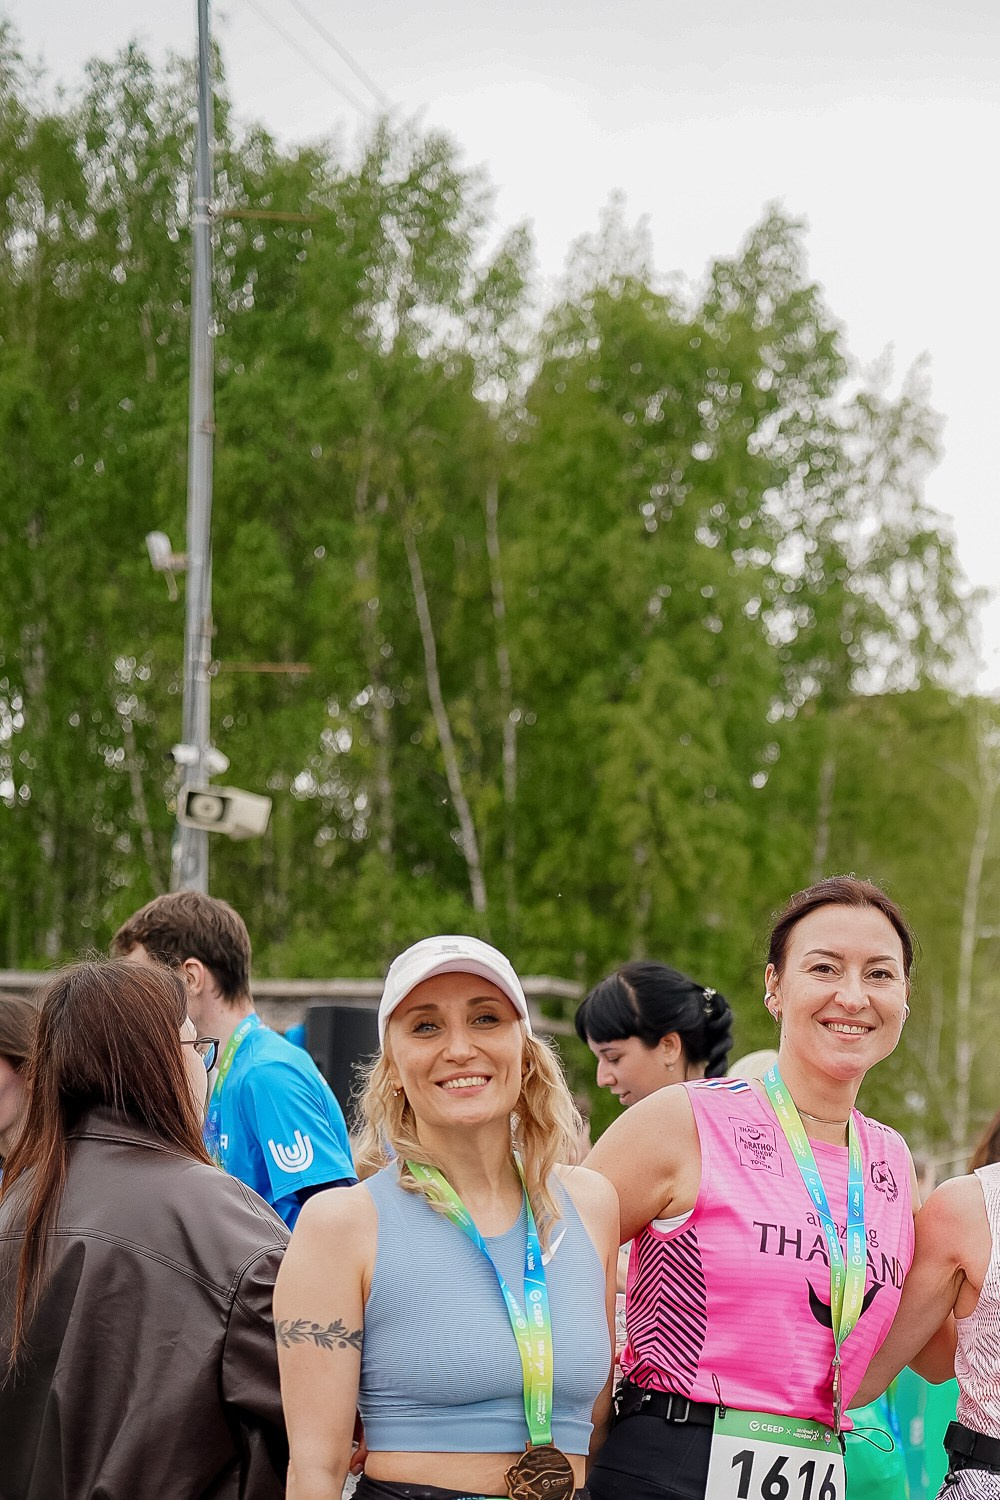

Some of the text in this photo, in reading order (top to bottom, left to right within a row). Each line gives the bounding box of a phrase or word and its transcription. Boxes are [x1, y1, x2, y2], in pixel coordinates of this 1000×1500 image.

[774, 1090, 784, 1104] 185
[829, 1235, 839, 1261] СБЕР
[853, 1232, 861, 1254] СБЕР
[532, 1302, 544, 1328] СБЕР
[761, 1423, 784, 1434] СБЕР
[550, 1477, 569, 1486] СБЕР
